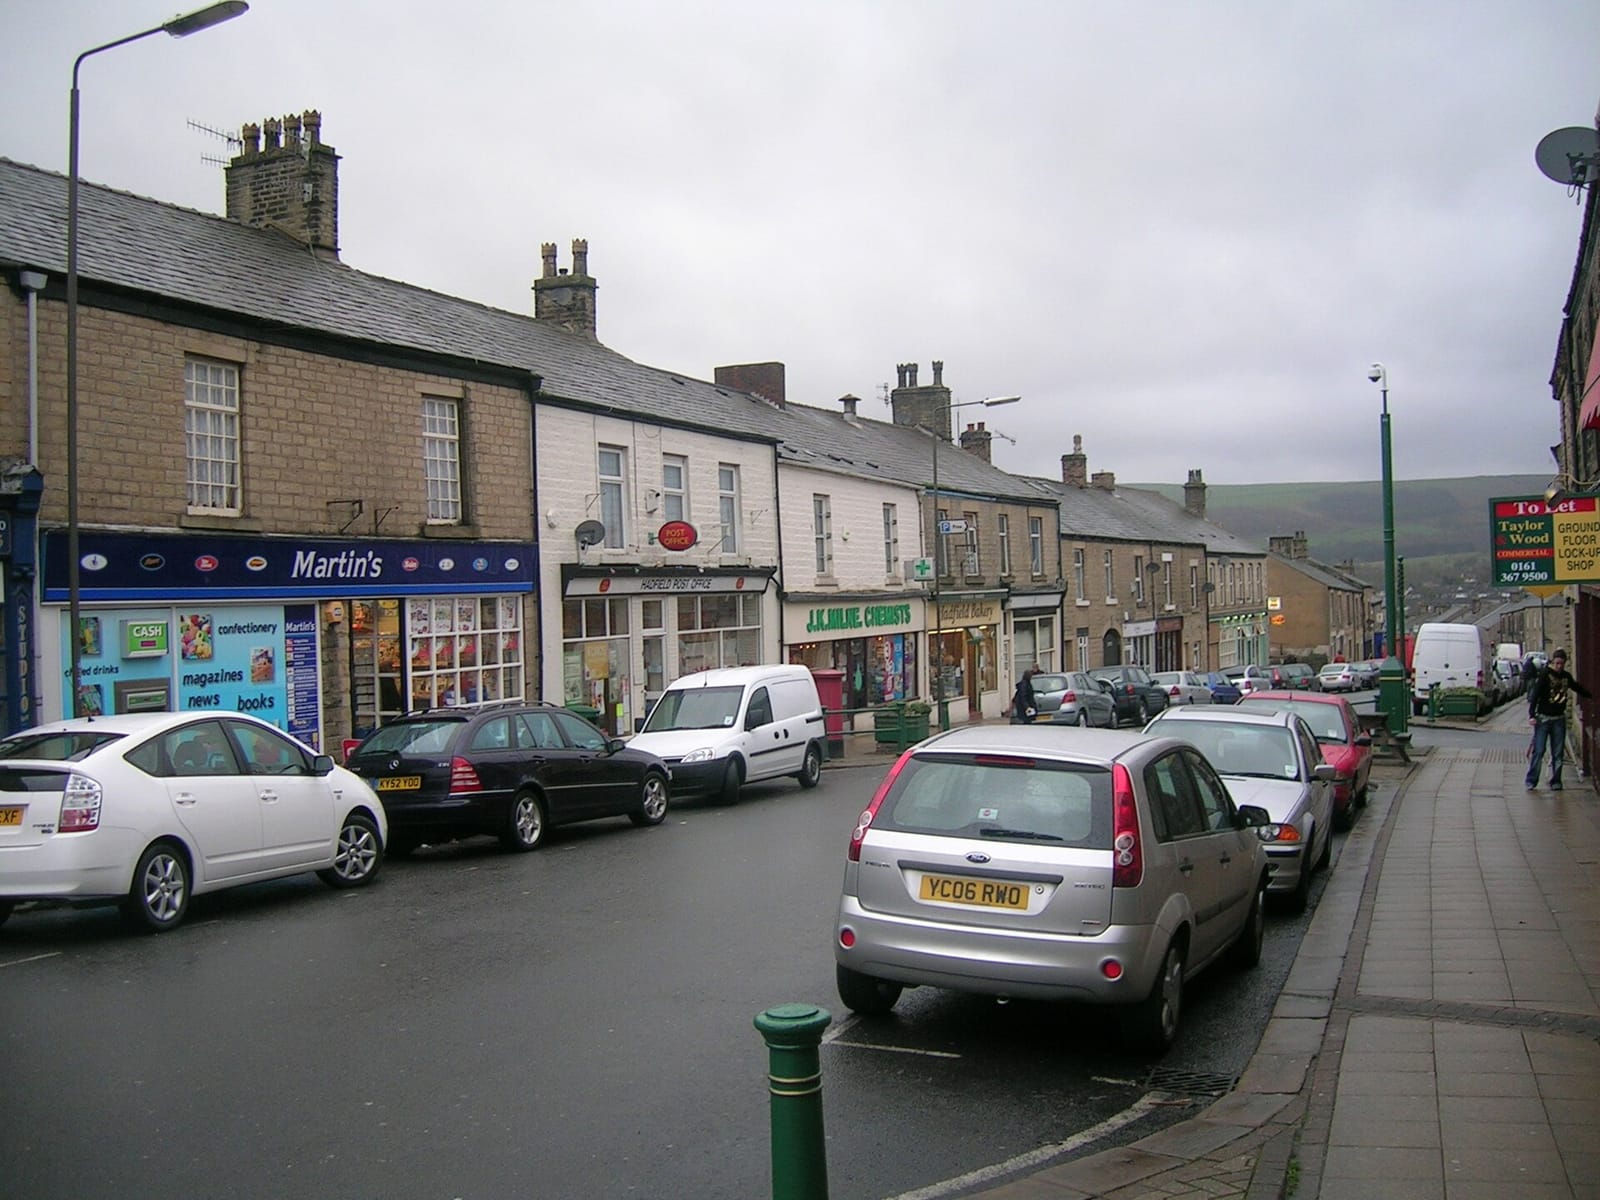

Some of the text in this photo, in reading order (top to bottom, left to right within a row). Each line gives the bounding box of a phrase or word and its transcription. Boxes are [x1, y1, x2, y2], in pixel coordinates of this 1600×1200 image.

[1513, 502, 1540, 515] To
[1499, 520, 1544, 532] Taylor
[1558, 522, 1600, 533] GROUND
[666, 529, 685, 537] POST
[1510, 533, 1549, 544] Wood
[664, 537, 689, 545] OFFICE
[1563, 535, 1597, 546] FLOOR
[1497, 549, 1550, 558] COMMERCIAL
[1558, 548, 1600, 559] LOCK-UP
[291, 550, 383, 578] Martin's
[1511, 562, 1537, 571] 0161
[1567, 560, 1594, 571] SHOP
[1501, 572, 1548, 582] 367 9500
[641, 578, 712, 590] HADFIELD POST OFFICE
[864, 603, 911, 628] CHEMISTS
[132, 625, 162, 637] CASH
[218, 622, 277, 635] confectionery
[286, 621, 315, 632] Martin's
[92, 664, 119, 676] drinks
[182, 668, 244, 688] magazines
[188, 693, 220, 708] news
[237, 692, 275, 711] books
[928, 878, 1021, 906] YC06 RWO
